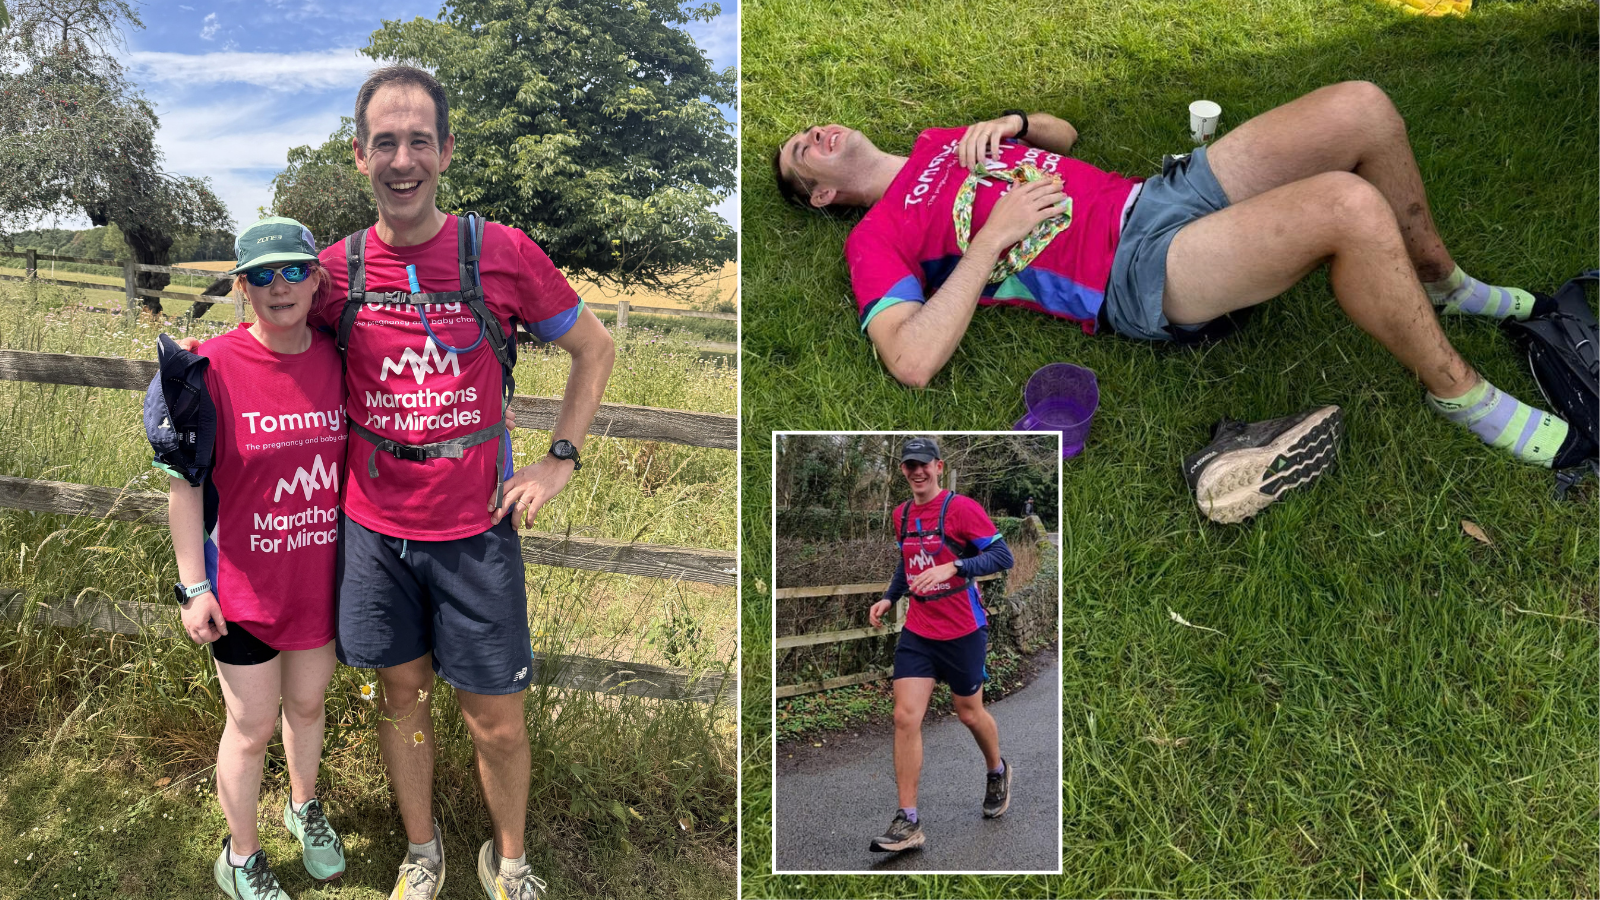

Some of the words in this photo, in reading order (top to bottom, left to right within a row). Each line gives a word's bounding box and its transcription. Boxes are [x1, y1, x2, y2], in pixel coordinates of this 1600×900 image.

[367, 319, 410, 327] pregnancy
[431, 316, 454, 326] baby
[364, 386, 478, 409] Marathons
[394, 407, 481, 431] Miracles
[245, 443, 261, 451] The
[262, 438, 303, 451] pregnancy
[304, 436, 319, 444] and
[320, 434, 337, 443] baby
[250, 534, 283, 553] For
